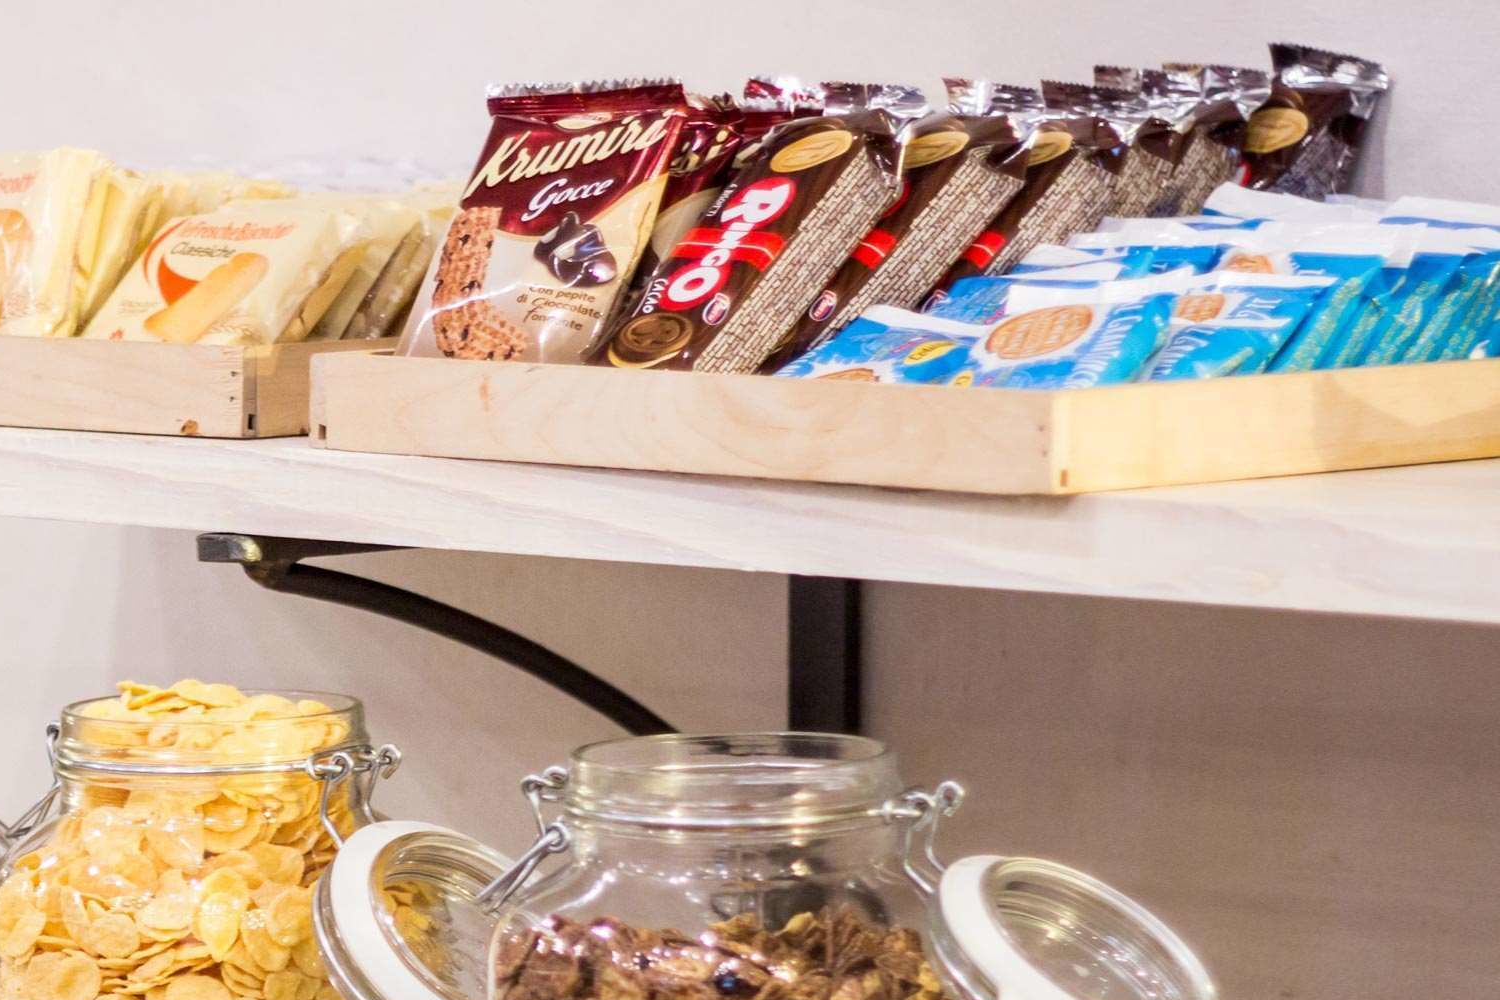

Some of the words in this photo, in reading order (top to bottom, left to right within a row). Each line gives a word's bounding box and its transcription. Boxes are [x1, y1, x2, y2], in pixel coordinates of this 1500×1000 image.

[460, 112, 668, 202] Krumiri
[520, 178, 614, 222] Gocce
[516, 293, 529, 304] di
[555, 290, 597, 304] pepite
